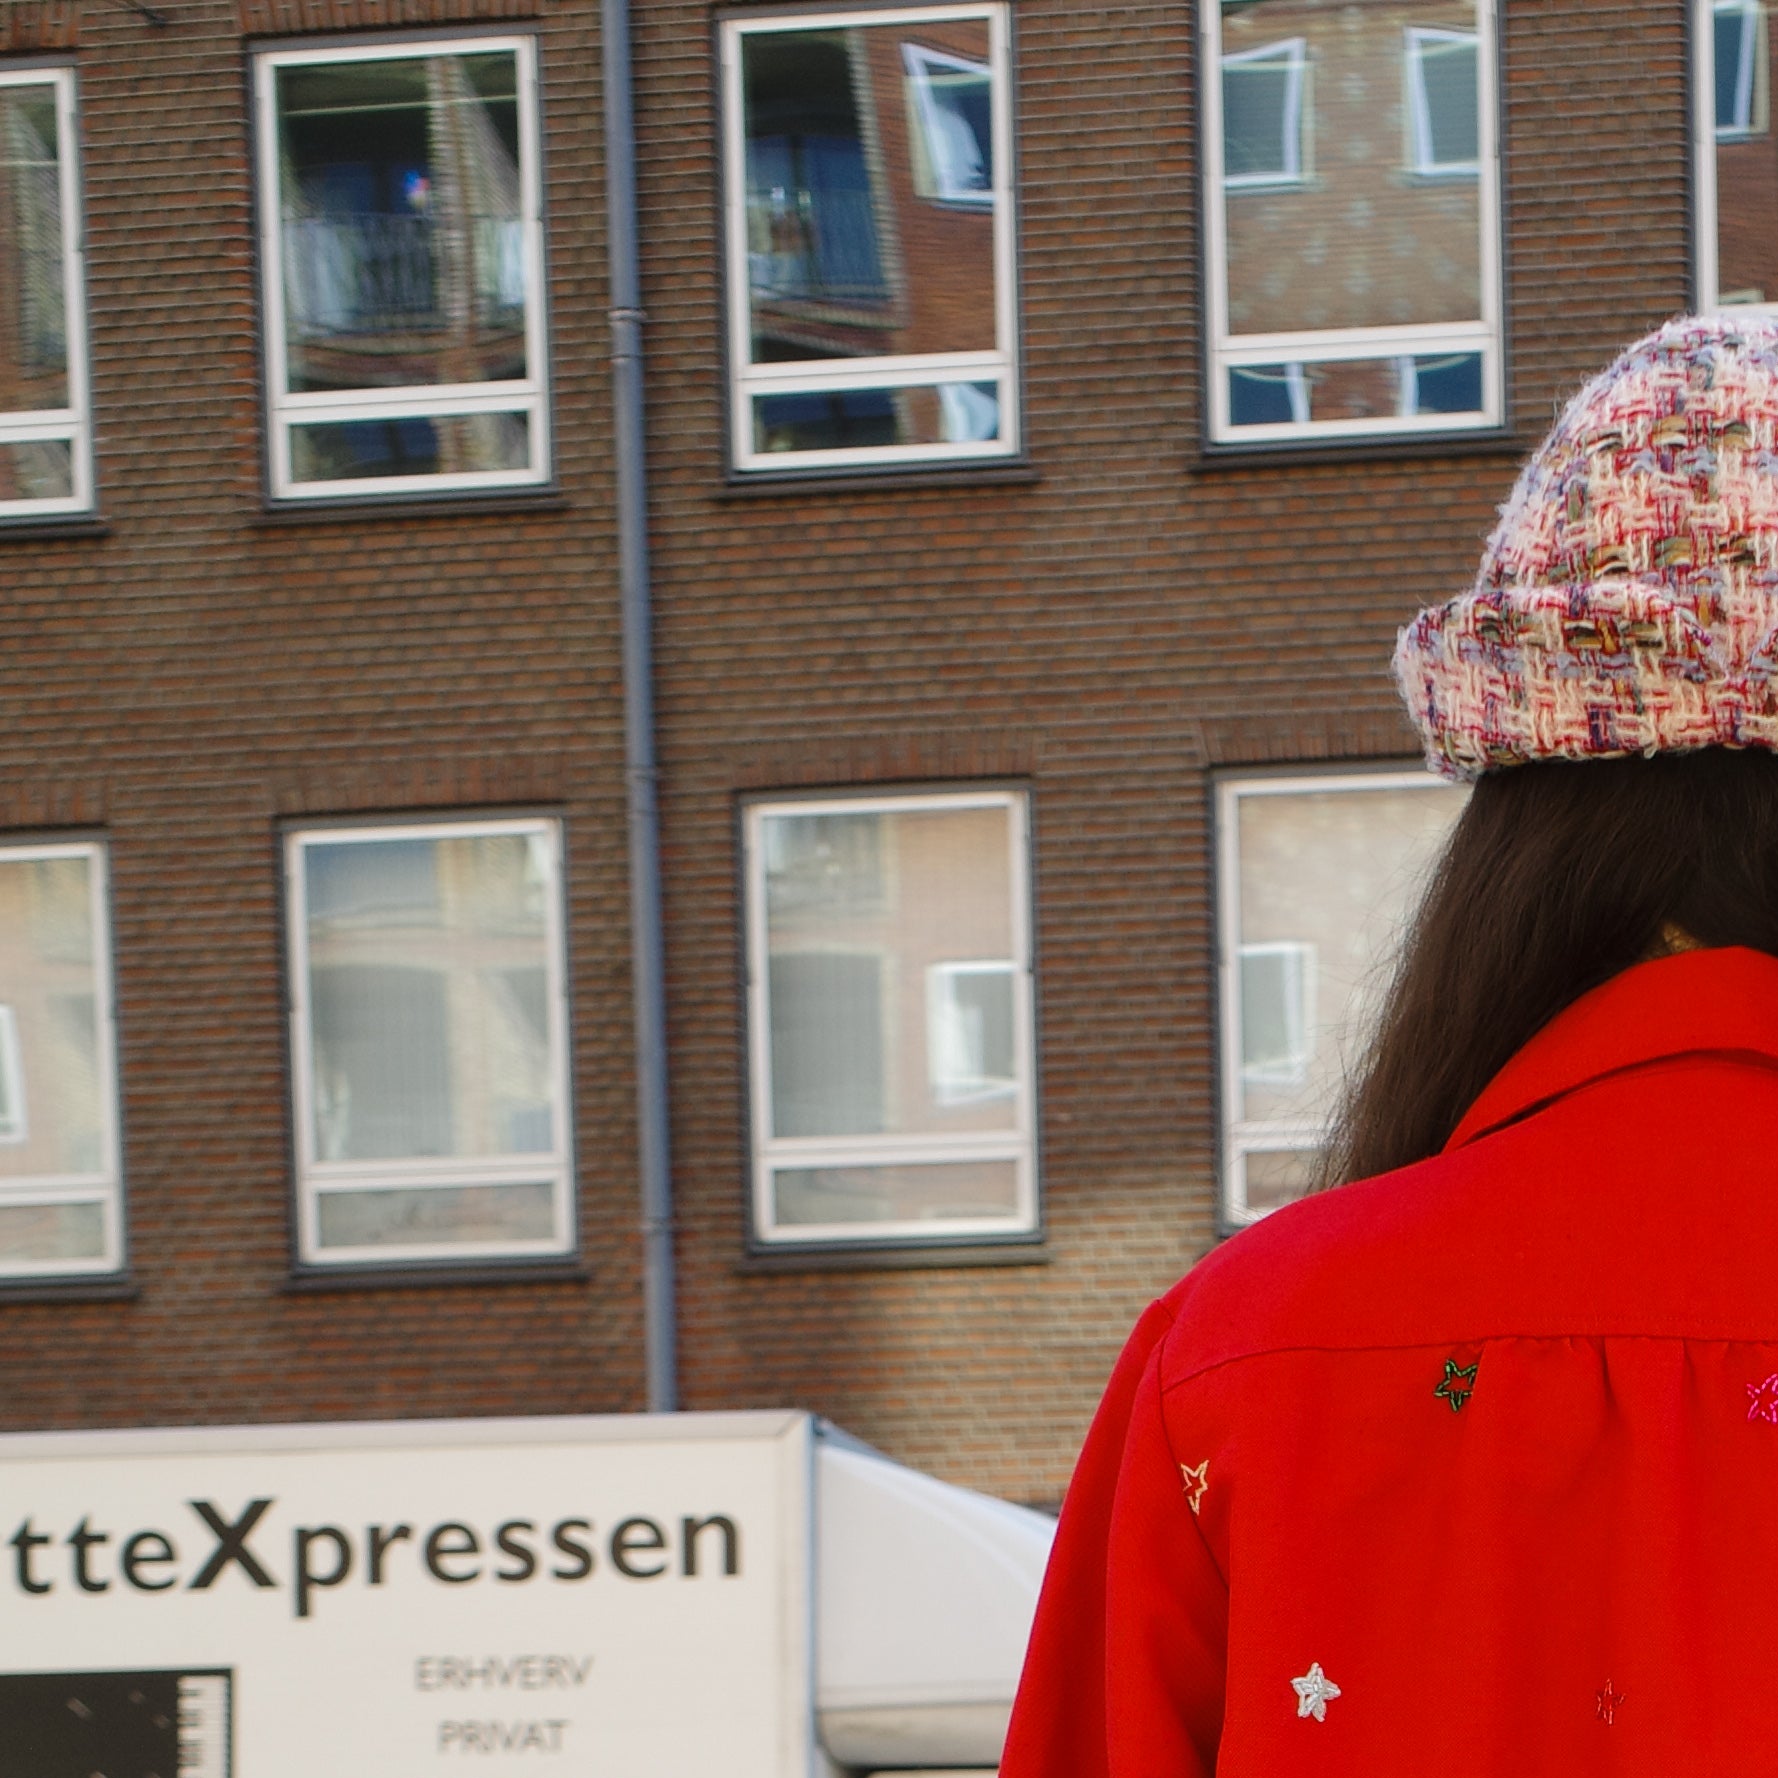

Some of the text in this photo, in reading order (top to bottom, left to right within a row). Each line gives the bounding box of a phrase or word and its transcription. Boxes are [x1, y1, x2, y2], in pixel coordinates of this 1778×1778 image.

[8, 1497, 741, 1617] tteXpressen
[414, 1655, 595, 1692] ERHVERV
[436, 1719, 571, 1755] PRIVAT
